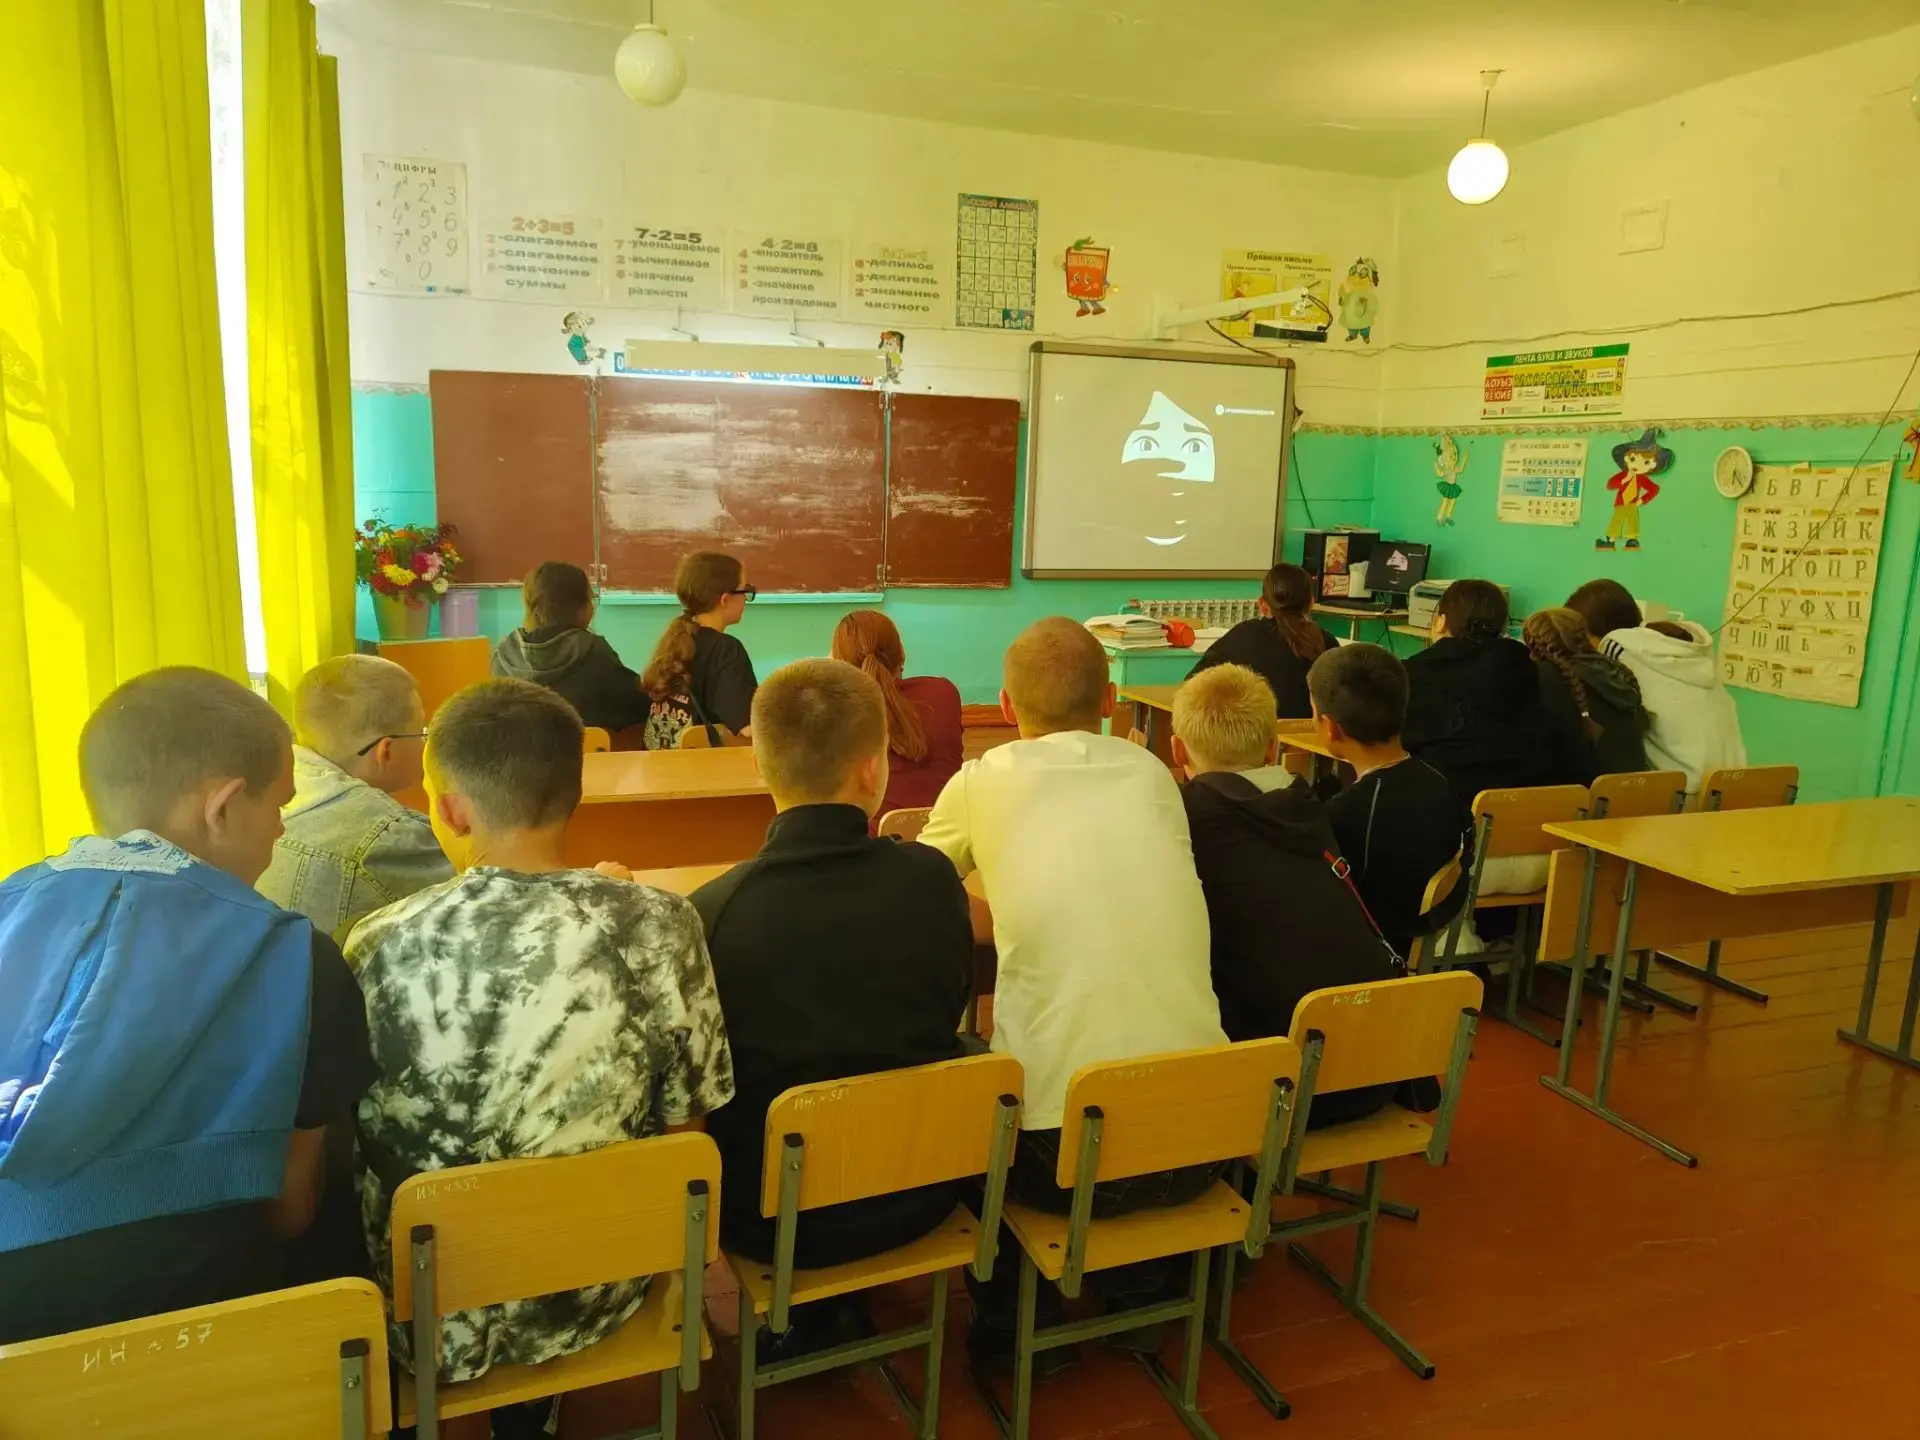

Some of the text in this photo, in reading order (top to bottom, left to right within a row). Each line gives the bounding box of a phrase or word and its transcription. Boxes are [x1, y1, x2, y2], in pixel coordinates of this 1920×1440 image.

[394, 163, 436, 174] ЦИФРЫ
[393, 181, 457, 206] 1 2 3
[392, 207, 458, 231] 4 5 6
[512, 216, 575, 235] 2+3=5
[615, 239, 625, 250] 7
[635, 228, 702, 244] 7-2=5
[418, 235, 431, 254] 8
[445, 238, 458, 257] 9
[616, 255, 626, 264] 2
[1247, 252, 1282, 262] Правила
[418, 261, 431, 280] 0
[506, 279, 566, 290] суммы
[629, 287, 688, 298] разности
[753, 295, 837, 308] произведения
[865, 300, 930, 312] частного
[1514, 348, 1593, 364] ЛЕНТА БУКВ И ЗВУКОВ
[1767, 479, 1778, 496] Б
[1790, 478, 1802, 496] В
[1815, 479, 1828, 497] Г
[1866, 478, 1878, 496] Е
[1763, 520, 1777, 538] Ж
[1787, 521, 1798, 538] З
[1808, 521, 1820, 540] И
[1833, 517, 1846, 539] Й
[1858, 521, 1872, 540] К
[1738, 555, 1749, 571] Л
[1761, 556, 1774, 575] М
[1805, 560, 1817, 577] О
[1828, 559, 1841, 577] П
[1855, 560, 1867, 578] Р
[1732, 592, 1861, 620] С Т У Ф Х Ц
[1729, 627, 1739, 643] Ч
[1752, 630, 1767, 648] Ш
[1776, 634, 1790, 653] Щ
[1725, 663, 1783, 689] Э Ю Я
[176, 1323, 213, 1350] 57
